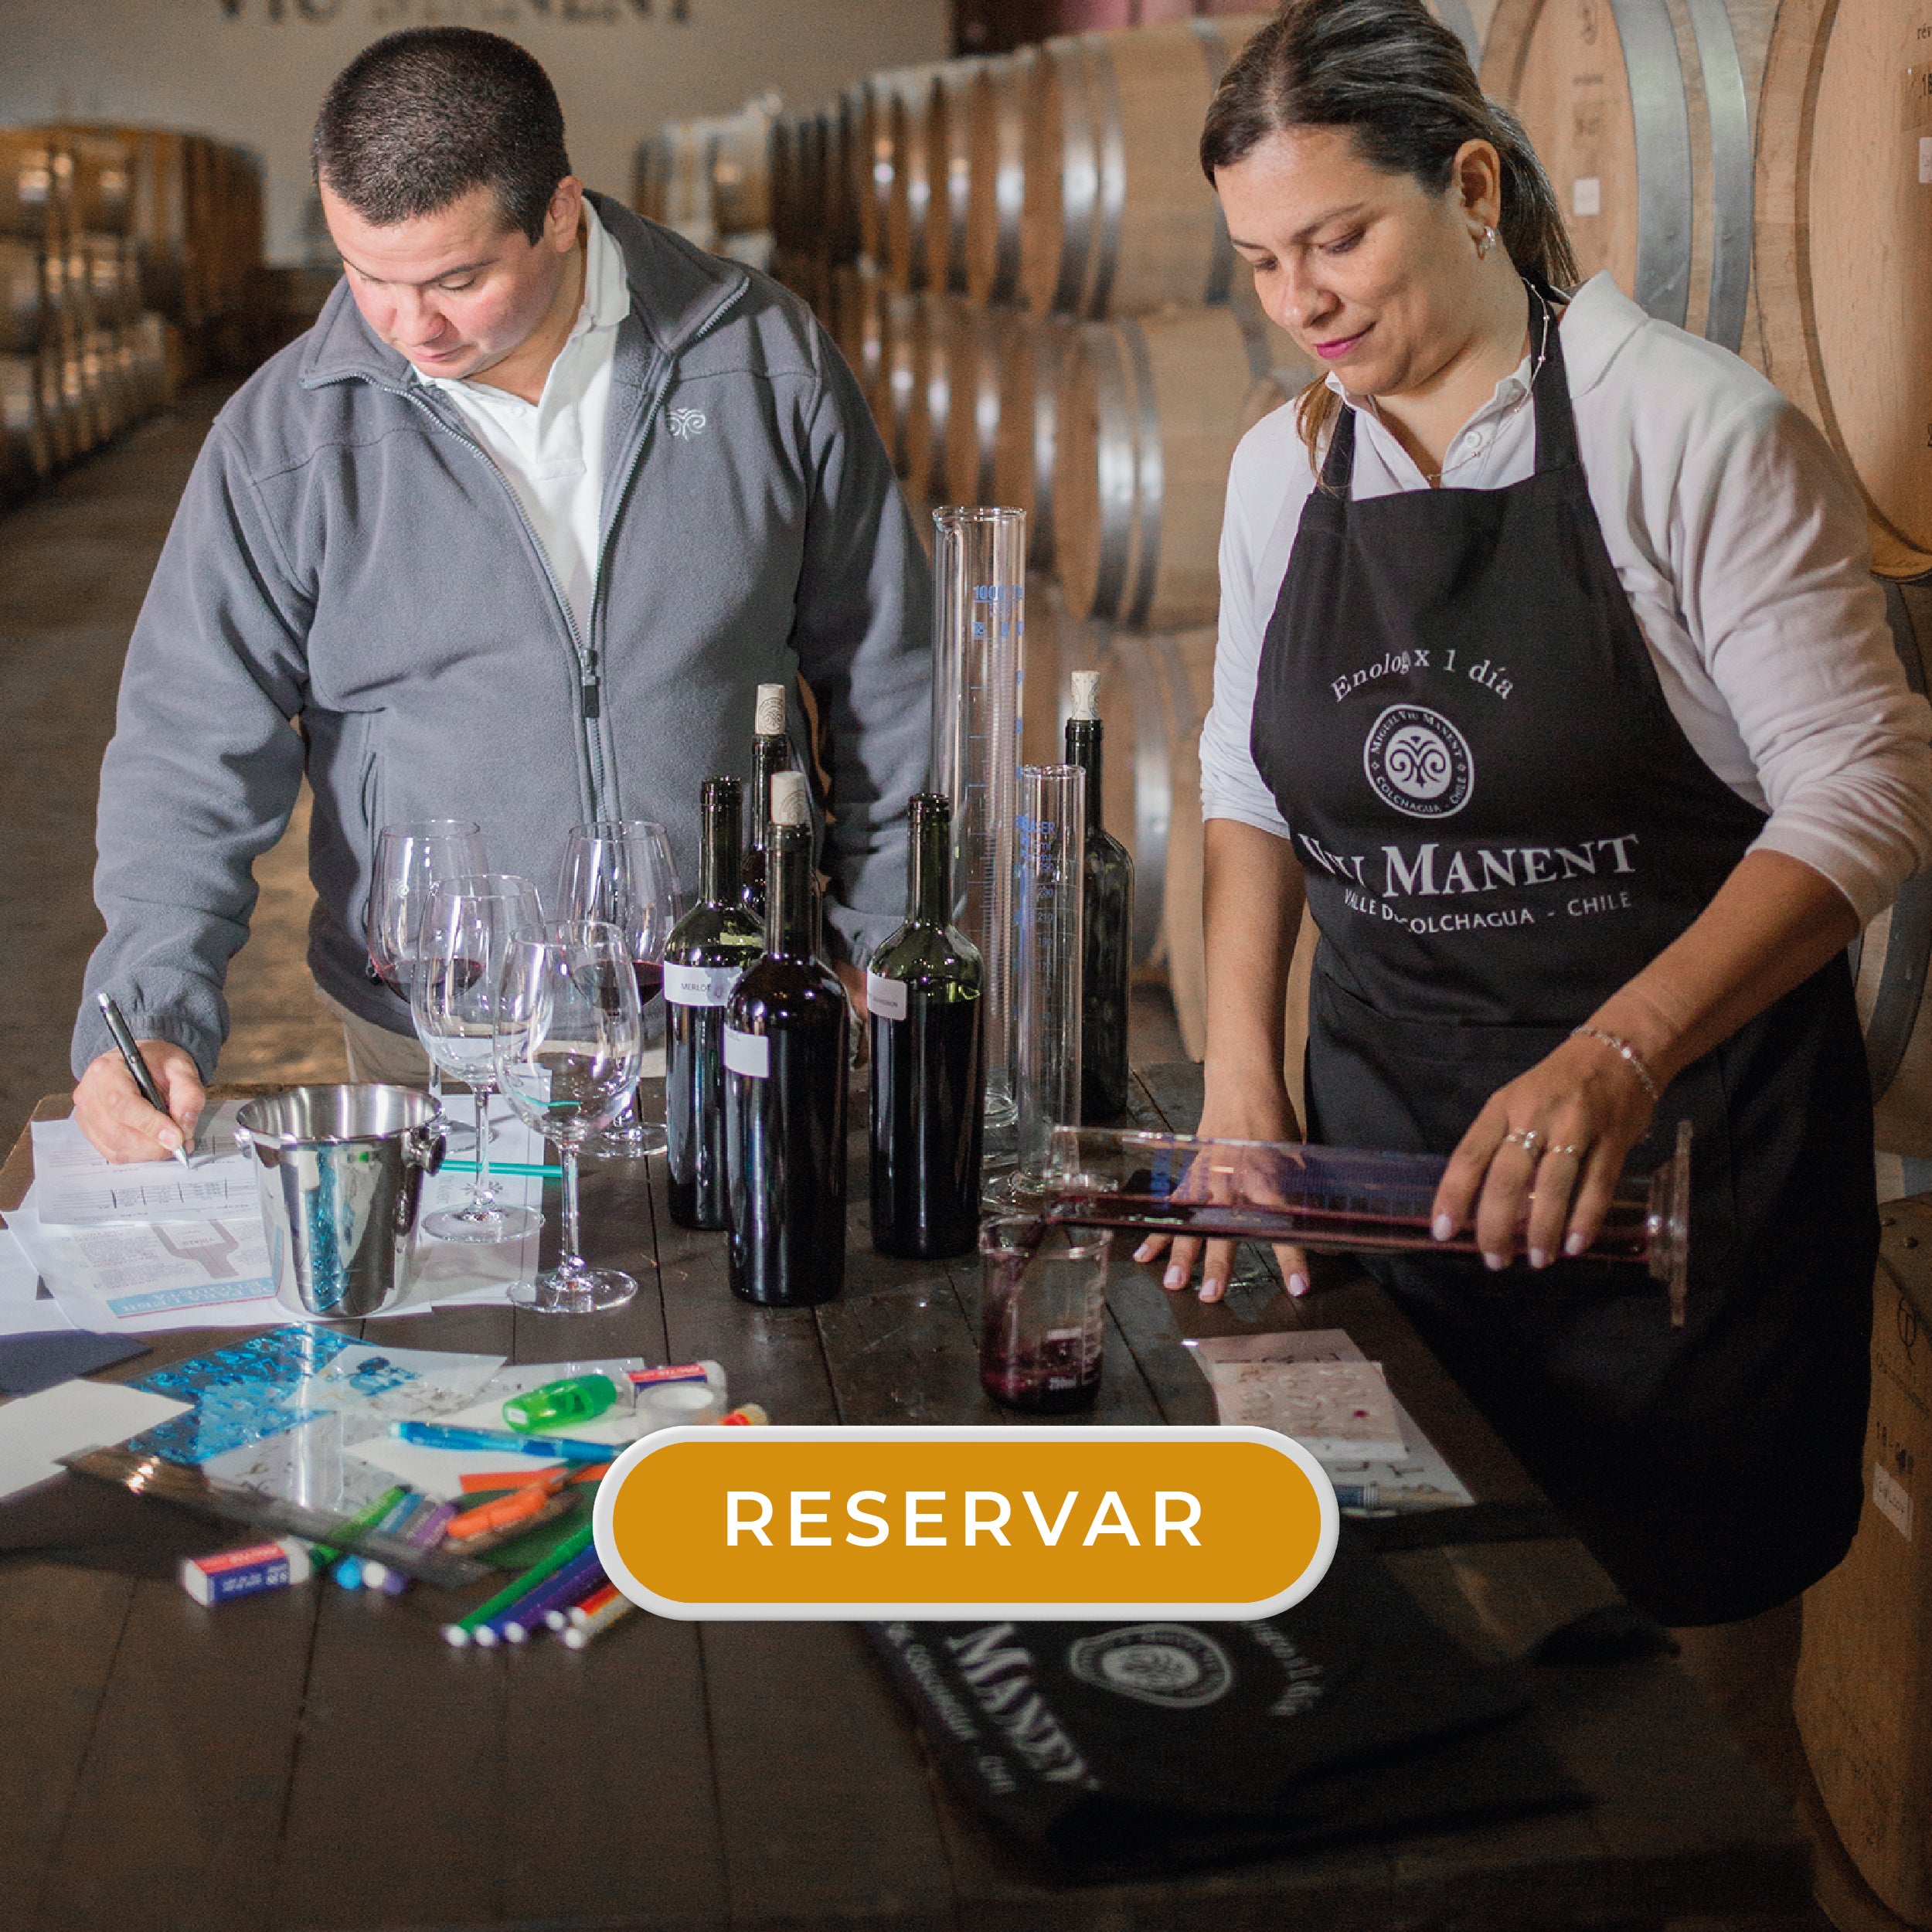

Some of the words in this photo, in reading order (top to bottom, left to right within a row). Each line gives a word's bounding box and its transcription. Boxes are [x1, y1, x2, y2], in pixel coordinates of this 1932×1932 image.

[1381, 834, 1639, 898] MANENT
[1408, 907, 1536, 934] OLCHAGUA
[1567, 891, 1632, 917] CHILE
